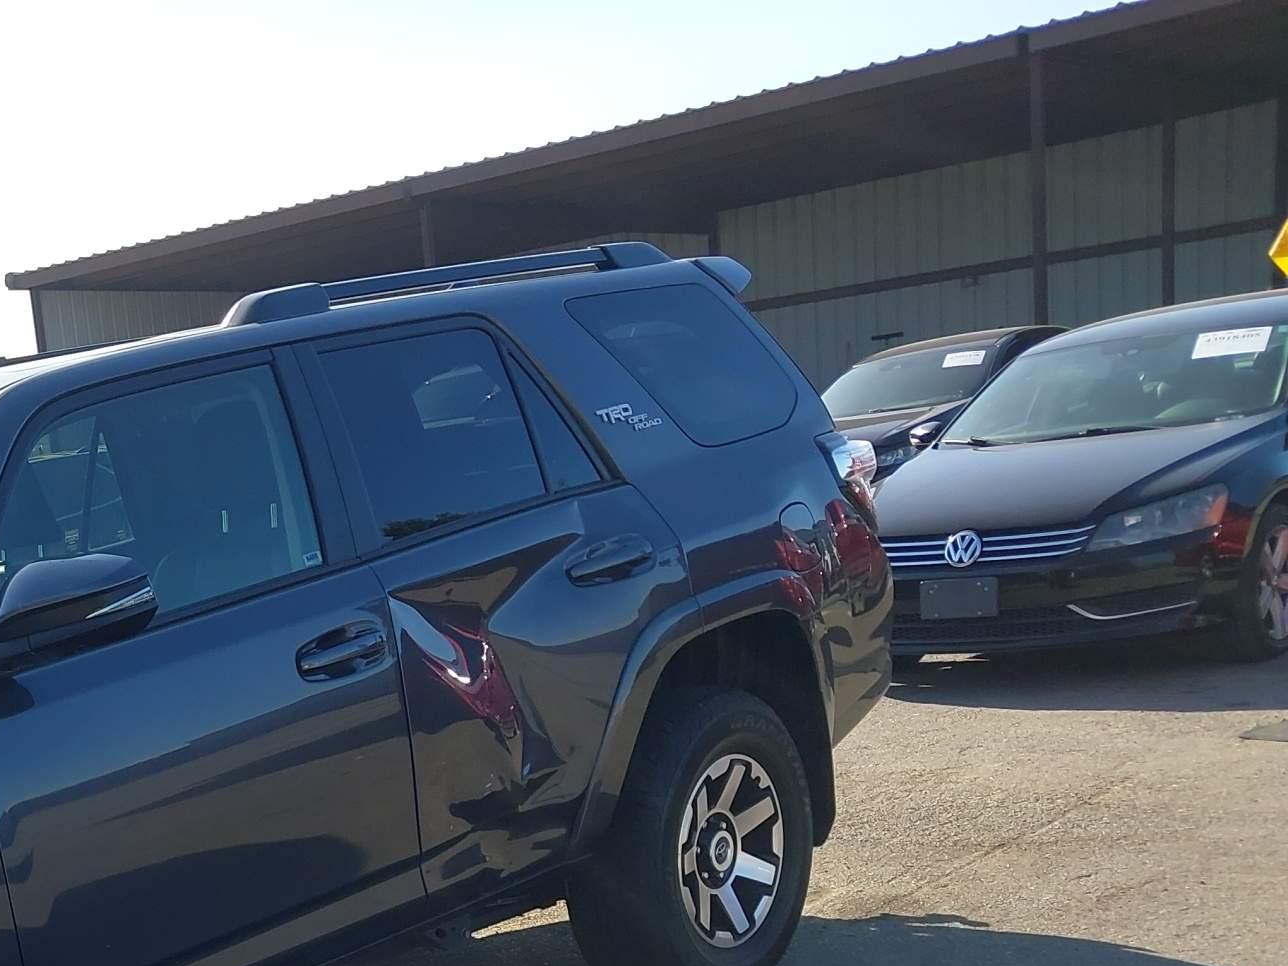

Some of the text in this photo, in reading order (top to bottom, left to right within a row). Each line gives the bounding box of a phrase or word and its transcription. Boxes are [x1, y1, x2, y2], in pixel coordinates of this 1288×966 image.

[596, 403, 632, 424] TRD
[628, 413, 648, 424] OFF
[634, 417, 662, 431] ROAD
[946, 531, 980, 566] VW
